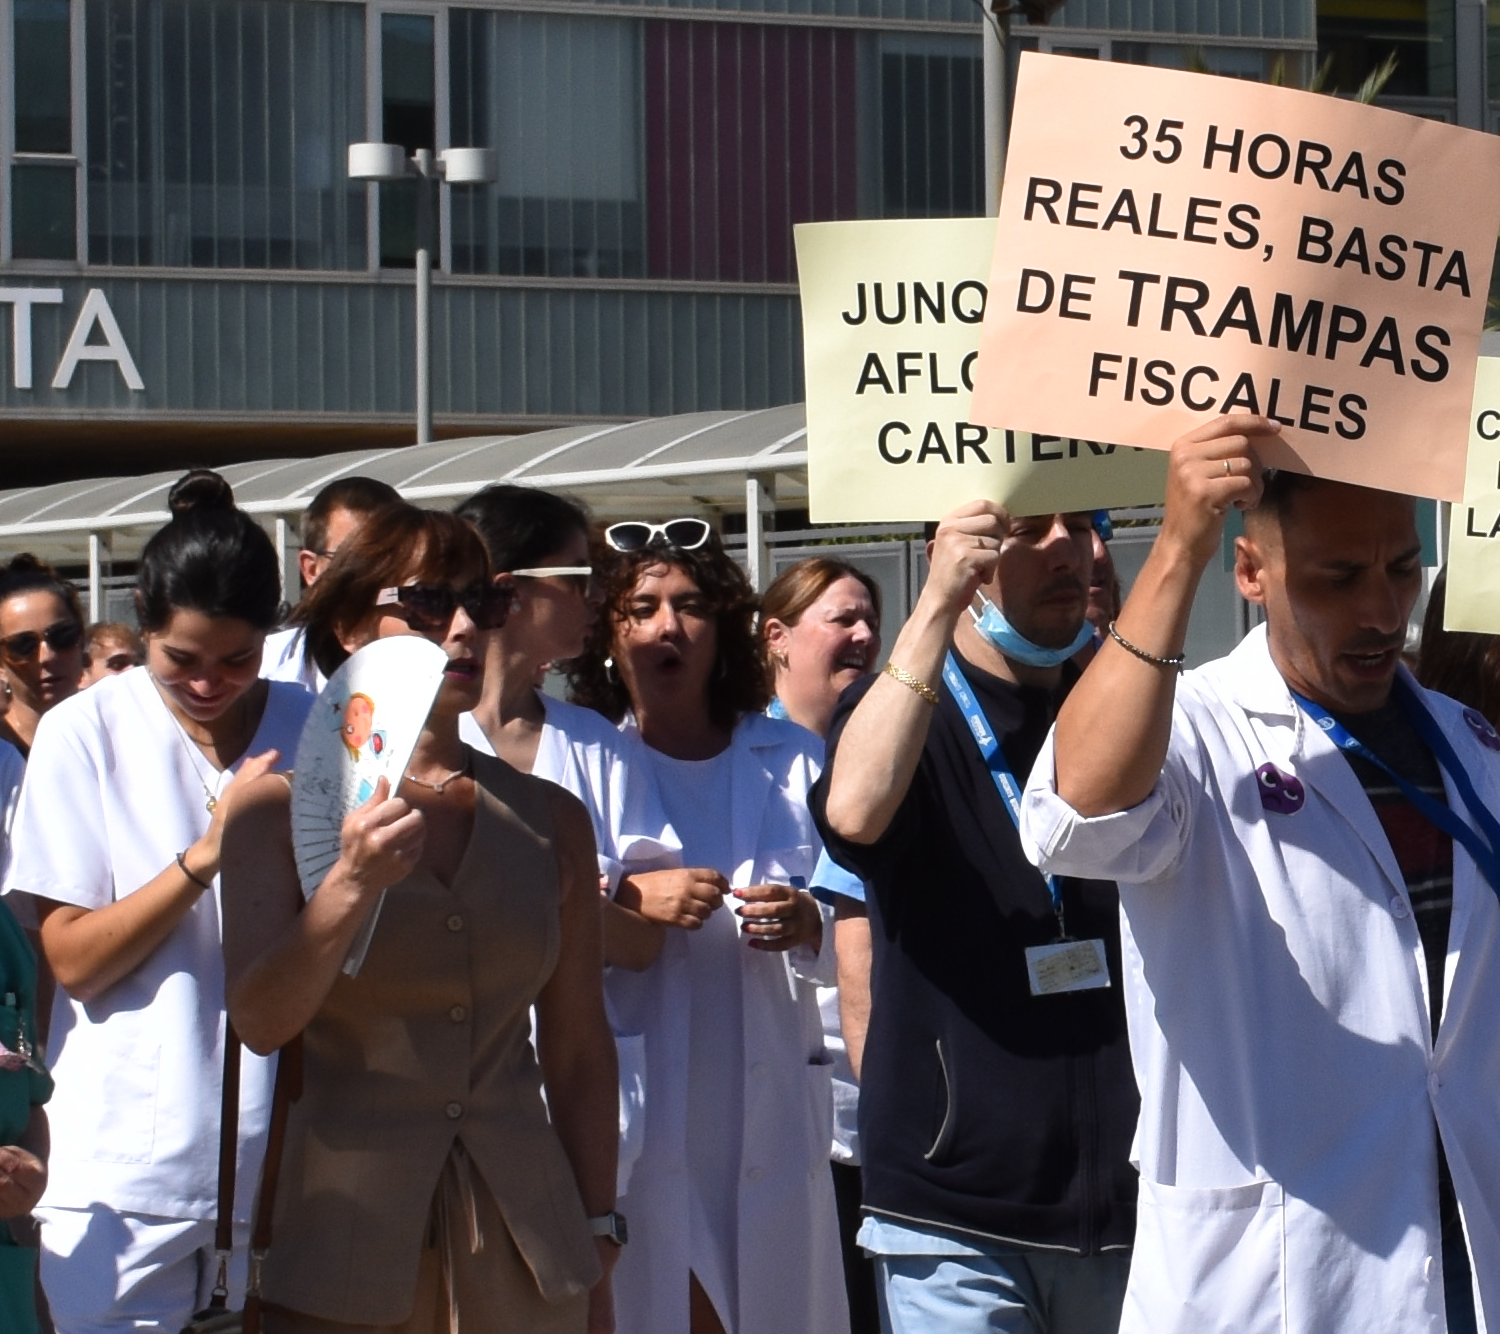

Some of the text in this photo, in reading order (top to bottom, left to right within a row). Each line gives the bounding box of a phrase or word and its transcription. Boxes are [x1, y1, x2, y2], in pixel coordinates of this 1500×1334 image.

[1118, 113, 1407, 208] 35 HORAS
[1021, 175, 1472, 300] REALES, BASTA
[1016, 267, 1453, 386] DE TRAMPAS
[1087, 351, 1369, 443] FISCALES
